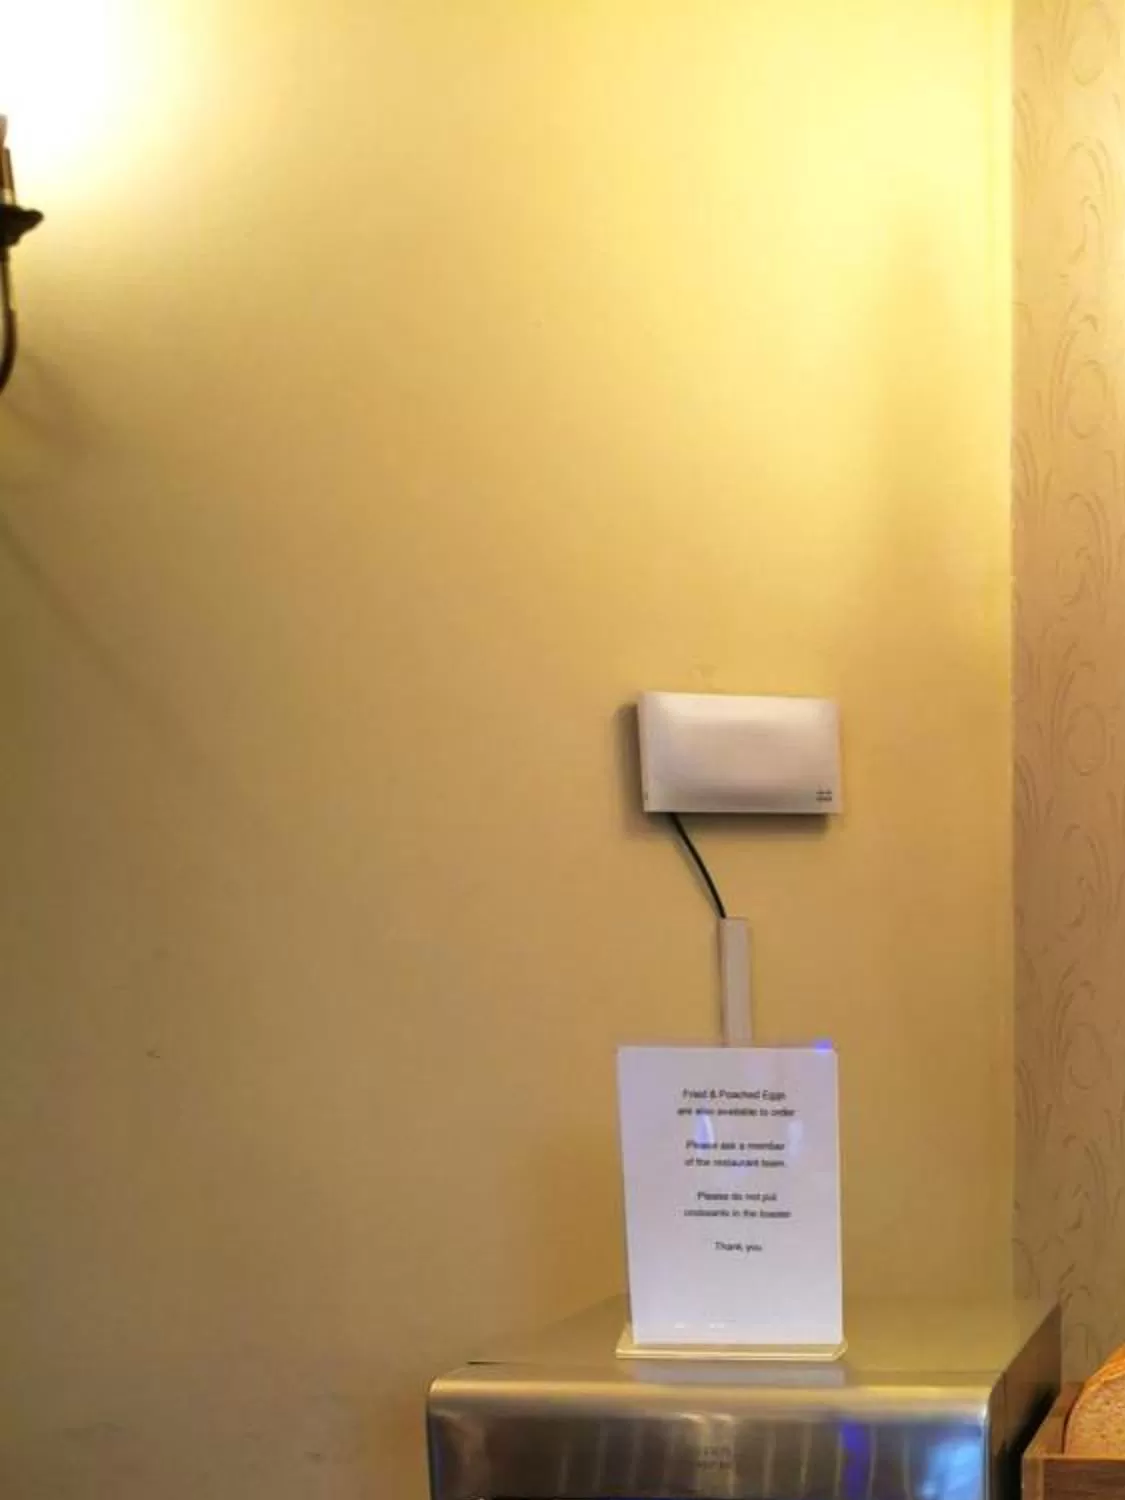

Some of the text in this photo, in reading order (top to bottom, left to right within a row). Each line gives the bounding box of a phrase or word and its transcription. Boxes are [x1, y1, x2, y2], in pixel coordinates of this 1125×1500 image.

[682, 1088, 707, 1099] Fried
[718, 1088, 761, 1100] Poached
[762, 1089, 786, 1102] Eggs
[677, 1107, 693, 1117] are
[695, 1106, 714, 1117] also
[717, 1106, 757, 1117] available
[759, 1107, 769, 1117] to
[685, 1139, 718, 1151] Please
[720, 1140, 736, 1151] ask
[747, 1139, 786, 1151] member
[684, 1157, 694, 1168] of
[695, 1157, 710, 1168] the
[713, 1157, 759, 1168] restaurant
[697, 1190, 777, 1203] Please do not put
[683, 1208, 730, 1218] croissants
[732, 1208, 741, 1218] in
[743, 1208, 757, 1218] the
[714, 1240, 743, 1252] Thank
